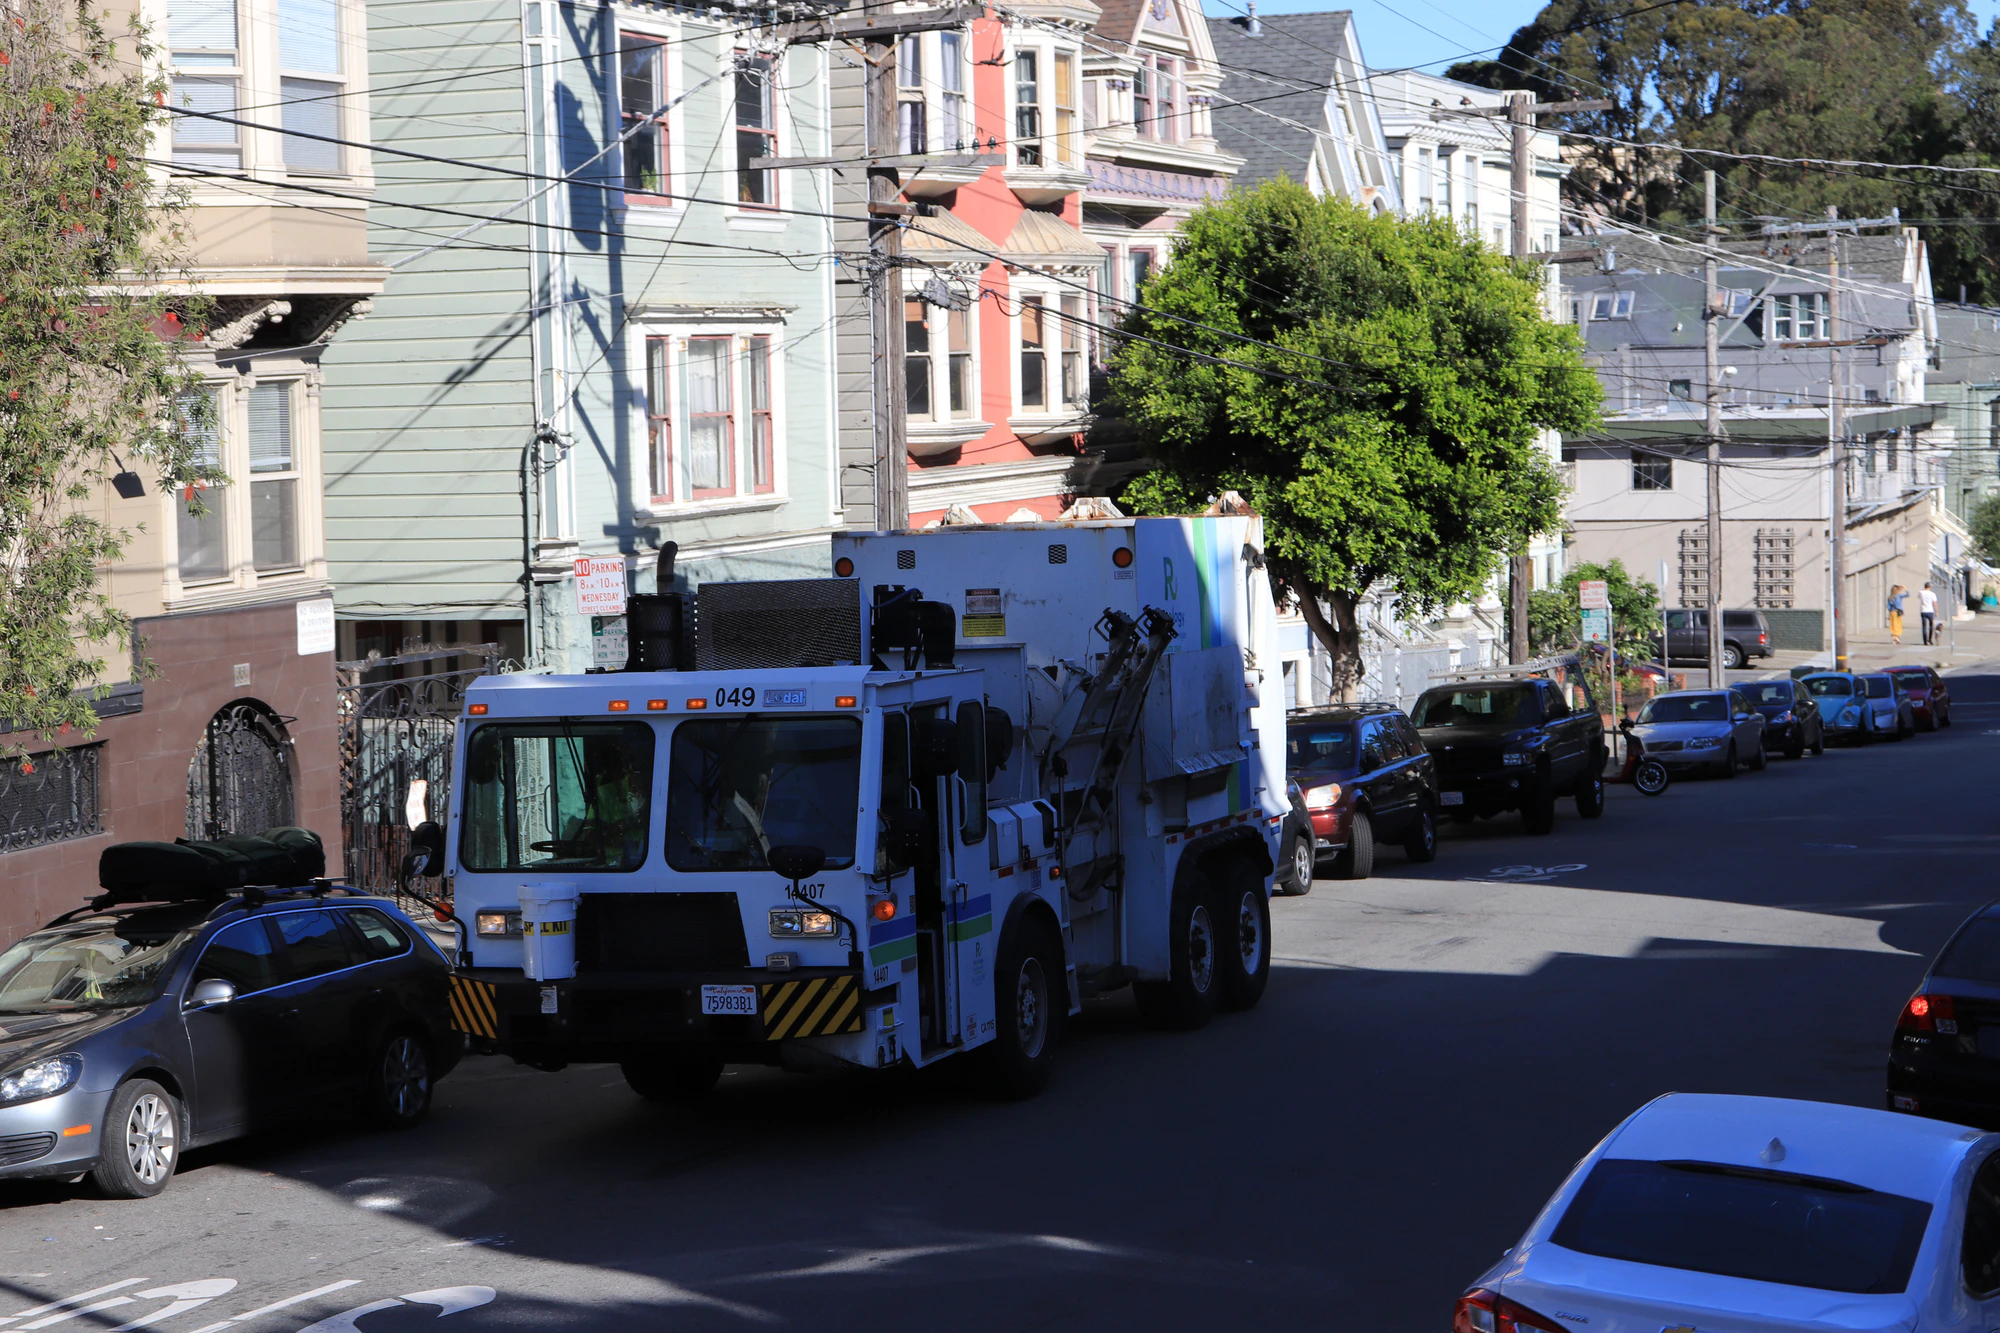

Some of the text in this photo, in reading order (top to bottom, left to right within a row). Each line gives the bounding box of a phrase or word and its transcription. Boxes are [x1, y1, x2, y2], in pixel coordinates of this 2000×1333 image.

[576, 561, 623, 575] NO PARKING
[582, 592, 619, 603] WEDNESDAY
[715, 687, 755, 707] 049
[524, 921, 567, 932] SPL KIT
[705, 996, 753, 1010] 75983B1
